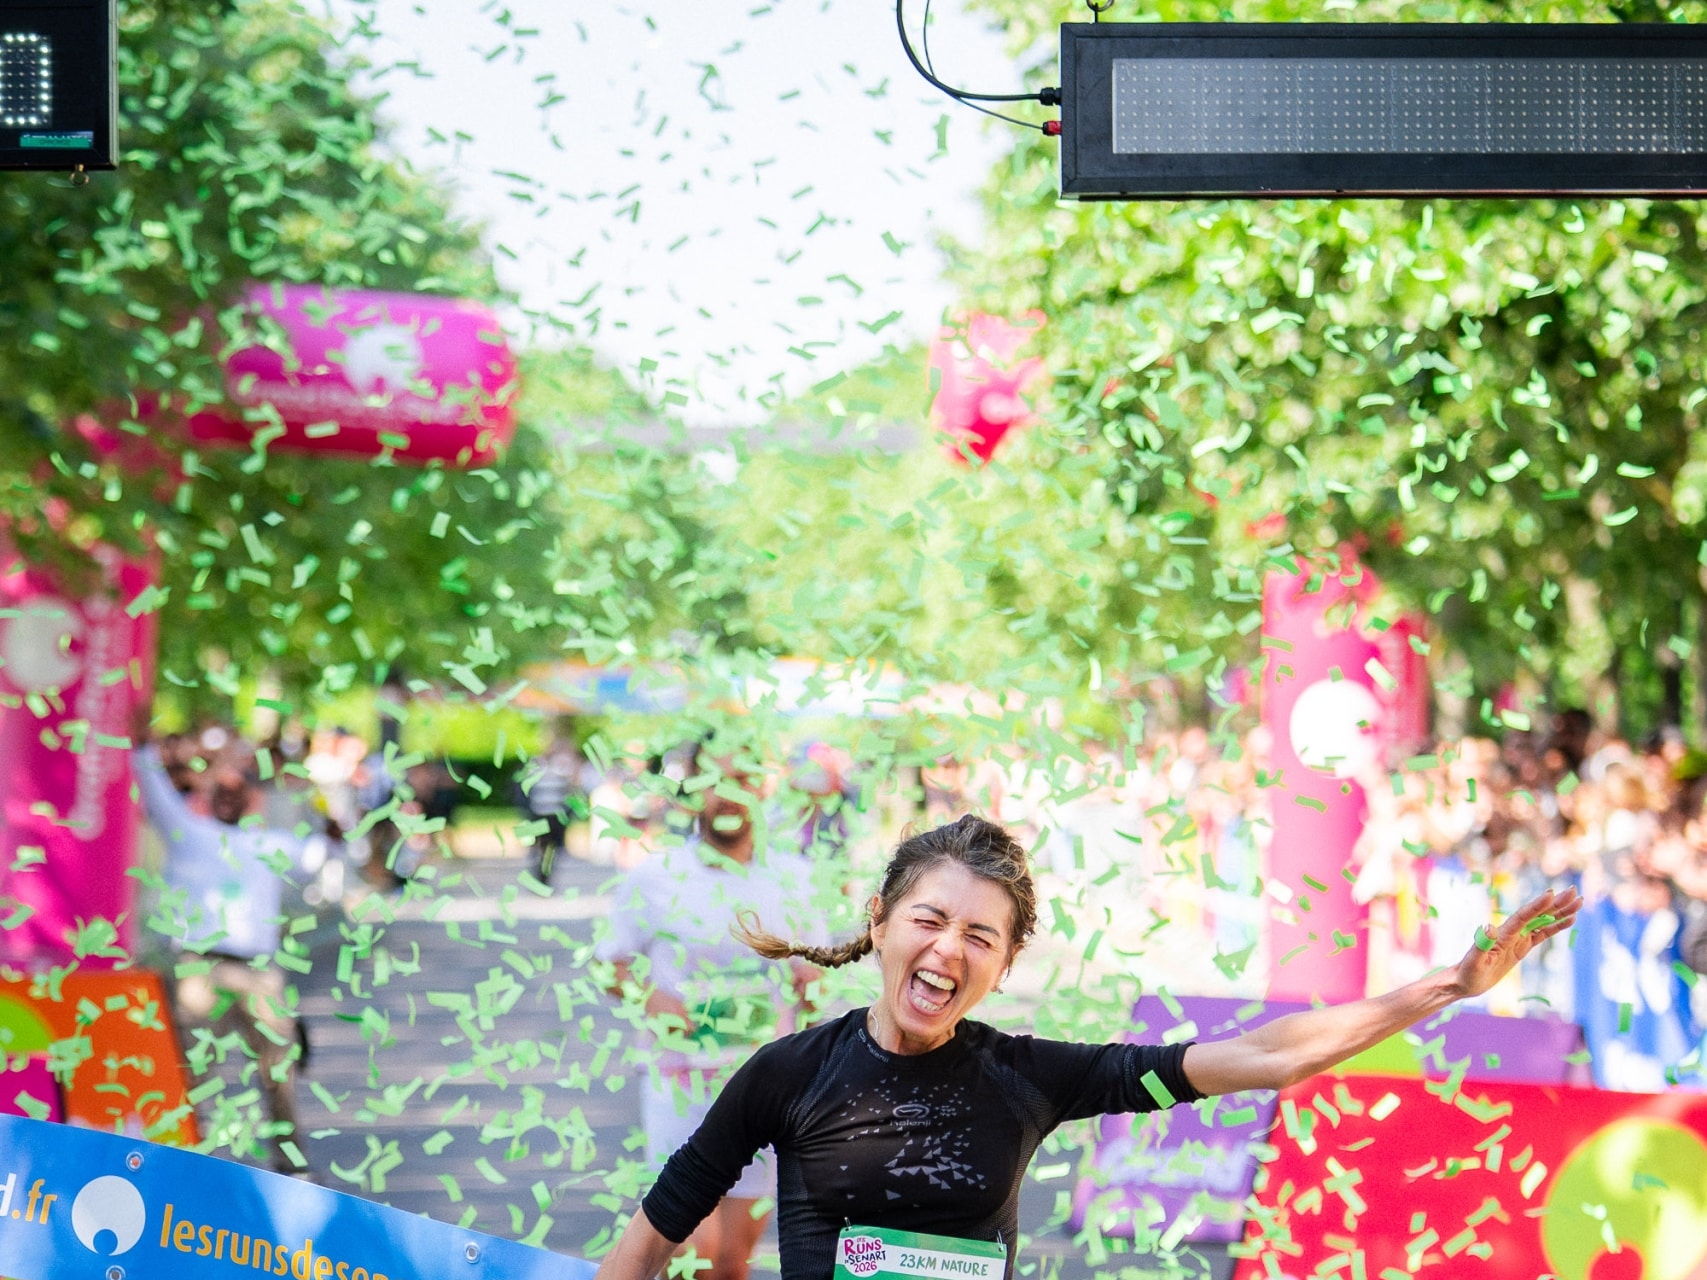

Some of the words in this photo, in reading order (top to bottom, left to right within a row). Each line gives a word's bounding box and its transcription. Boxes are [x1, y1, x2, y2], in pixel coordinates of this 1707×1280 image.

[844, 1238, 882, 1256] RUNS
[854, 1260, 877, 1273] 2026
[900, 1253, 936, 1270] 23KM
[940, 1259, 989, 1276] NATURE
